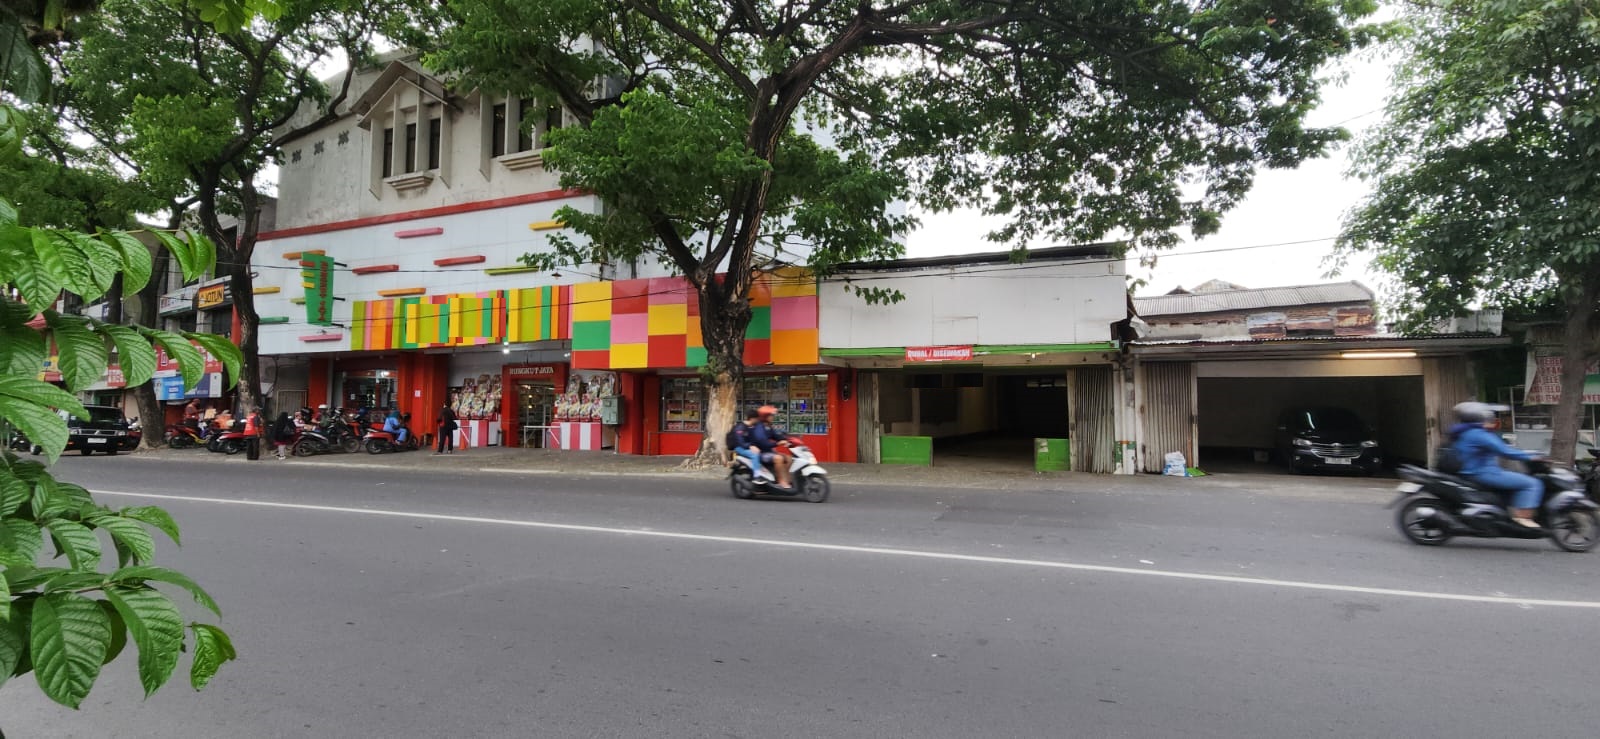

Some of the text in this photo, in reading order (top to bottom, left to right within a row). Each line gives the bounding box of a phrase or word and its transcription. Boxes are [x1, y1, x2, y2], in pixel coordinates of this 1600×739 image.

[205, 287, 223, 303] JOTUN
[510, 367, 554, 375] RUNGKUT JAYA
